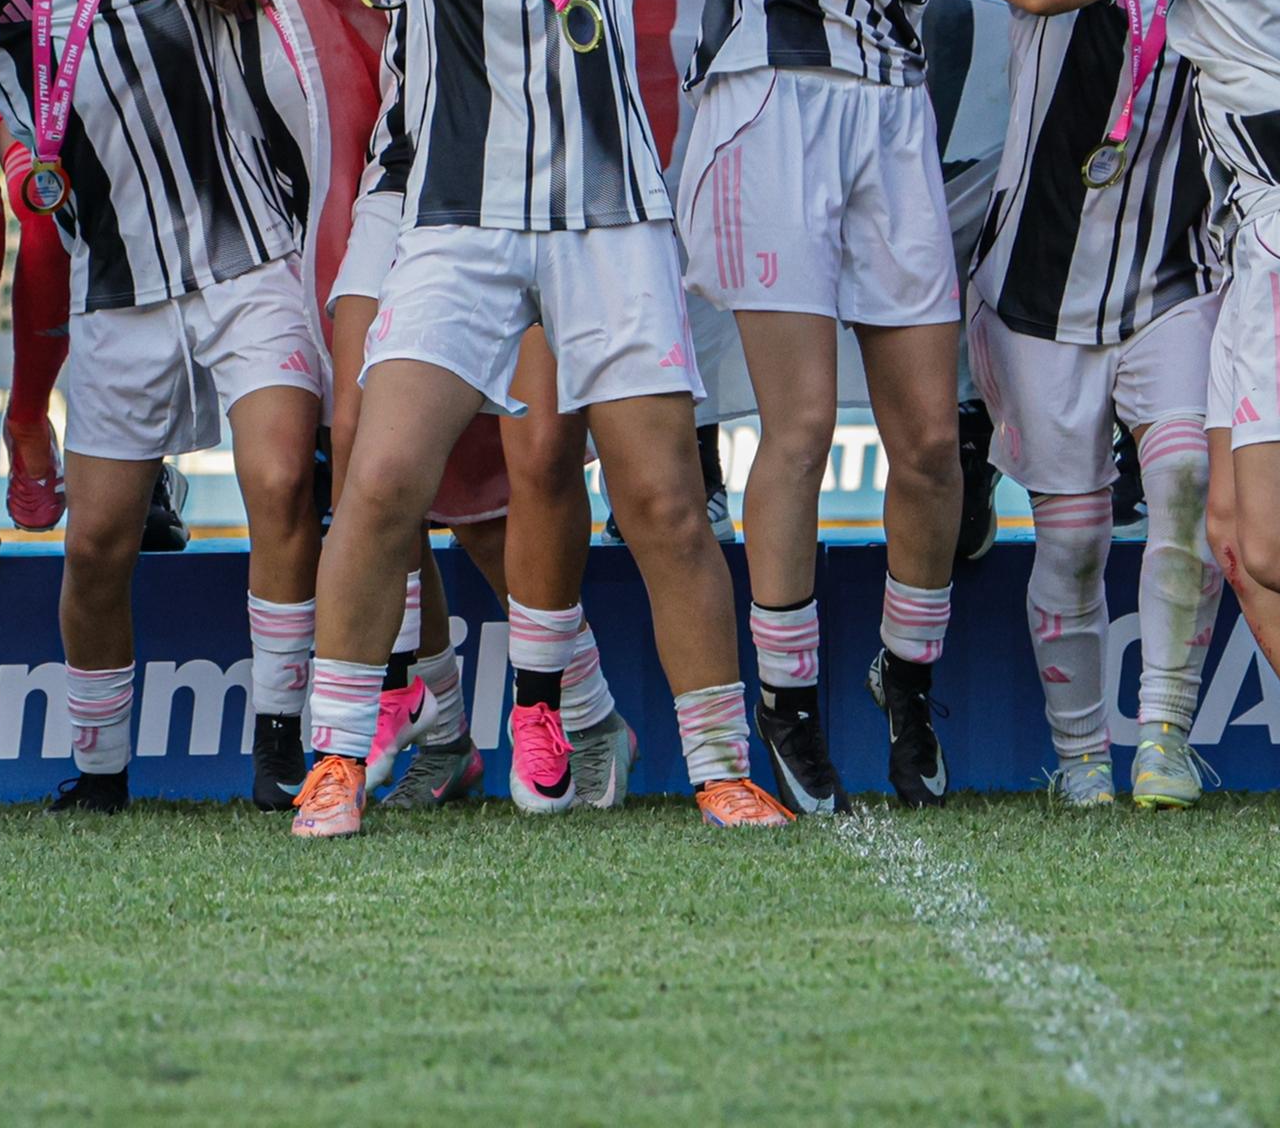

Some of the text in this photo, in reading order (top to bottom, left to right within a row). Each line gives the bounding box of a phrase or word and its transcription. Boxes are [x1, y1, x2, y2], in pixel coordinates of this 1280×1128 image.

[38, 27, 46, 47] TIM
[67, 44, 78, 66] TIM
[39, 64, 50, 101] FINALI
[57, 91, 70, 132] CAMPIONATI
